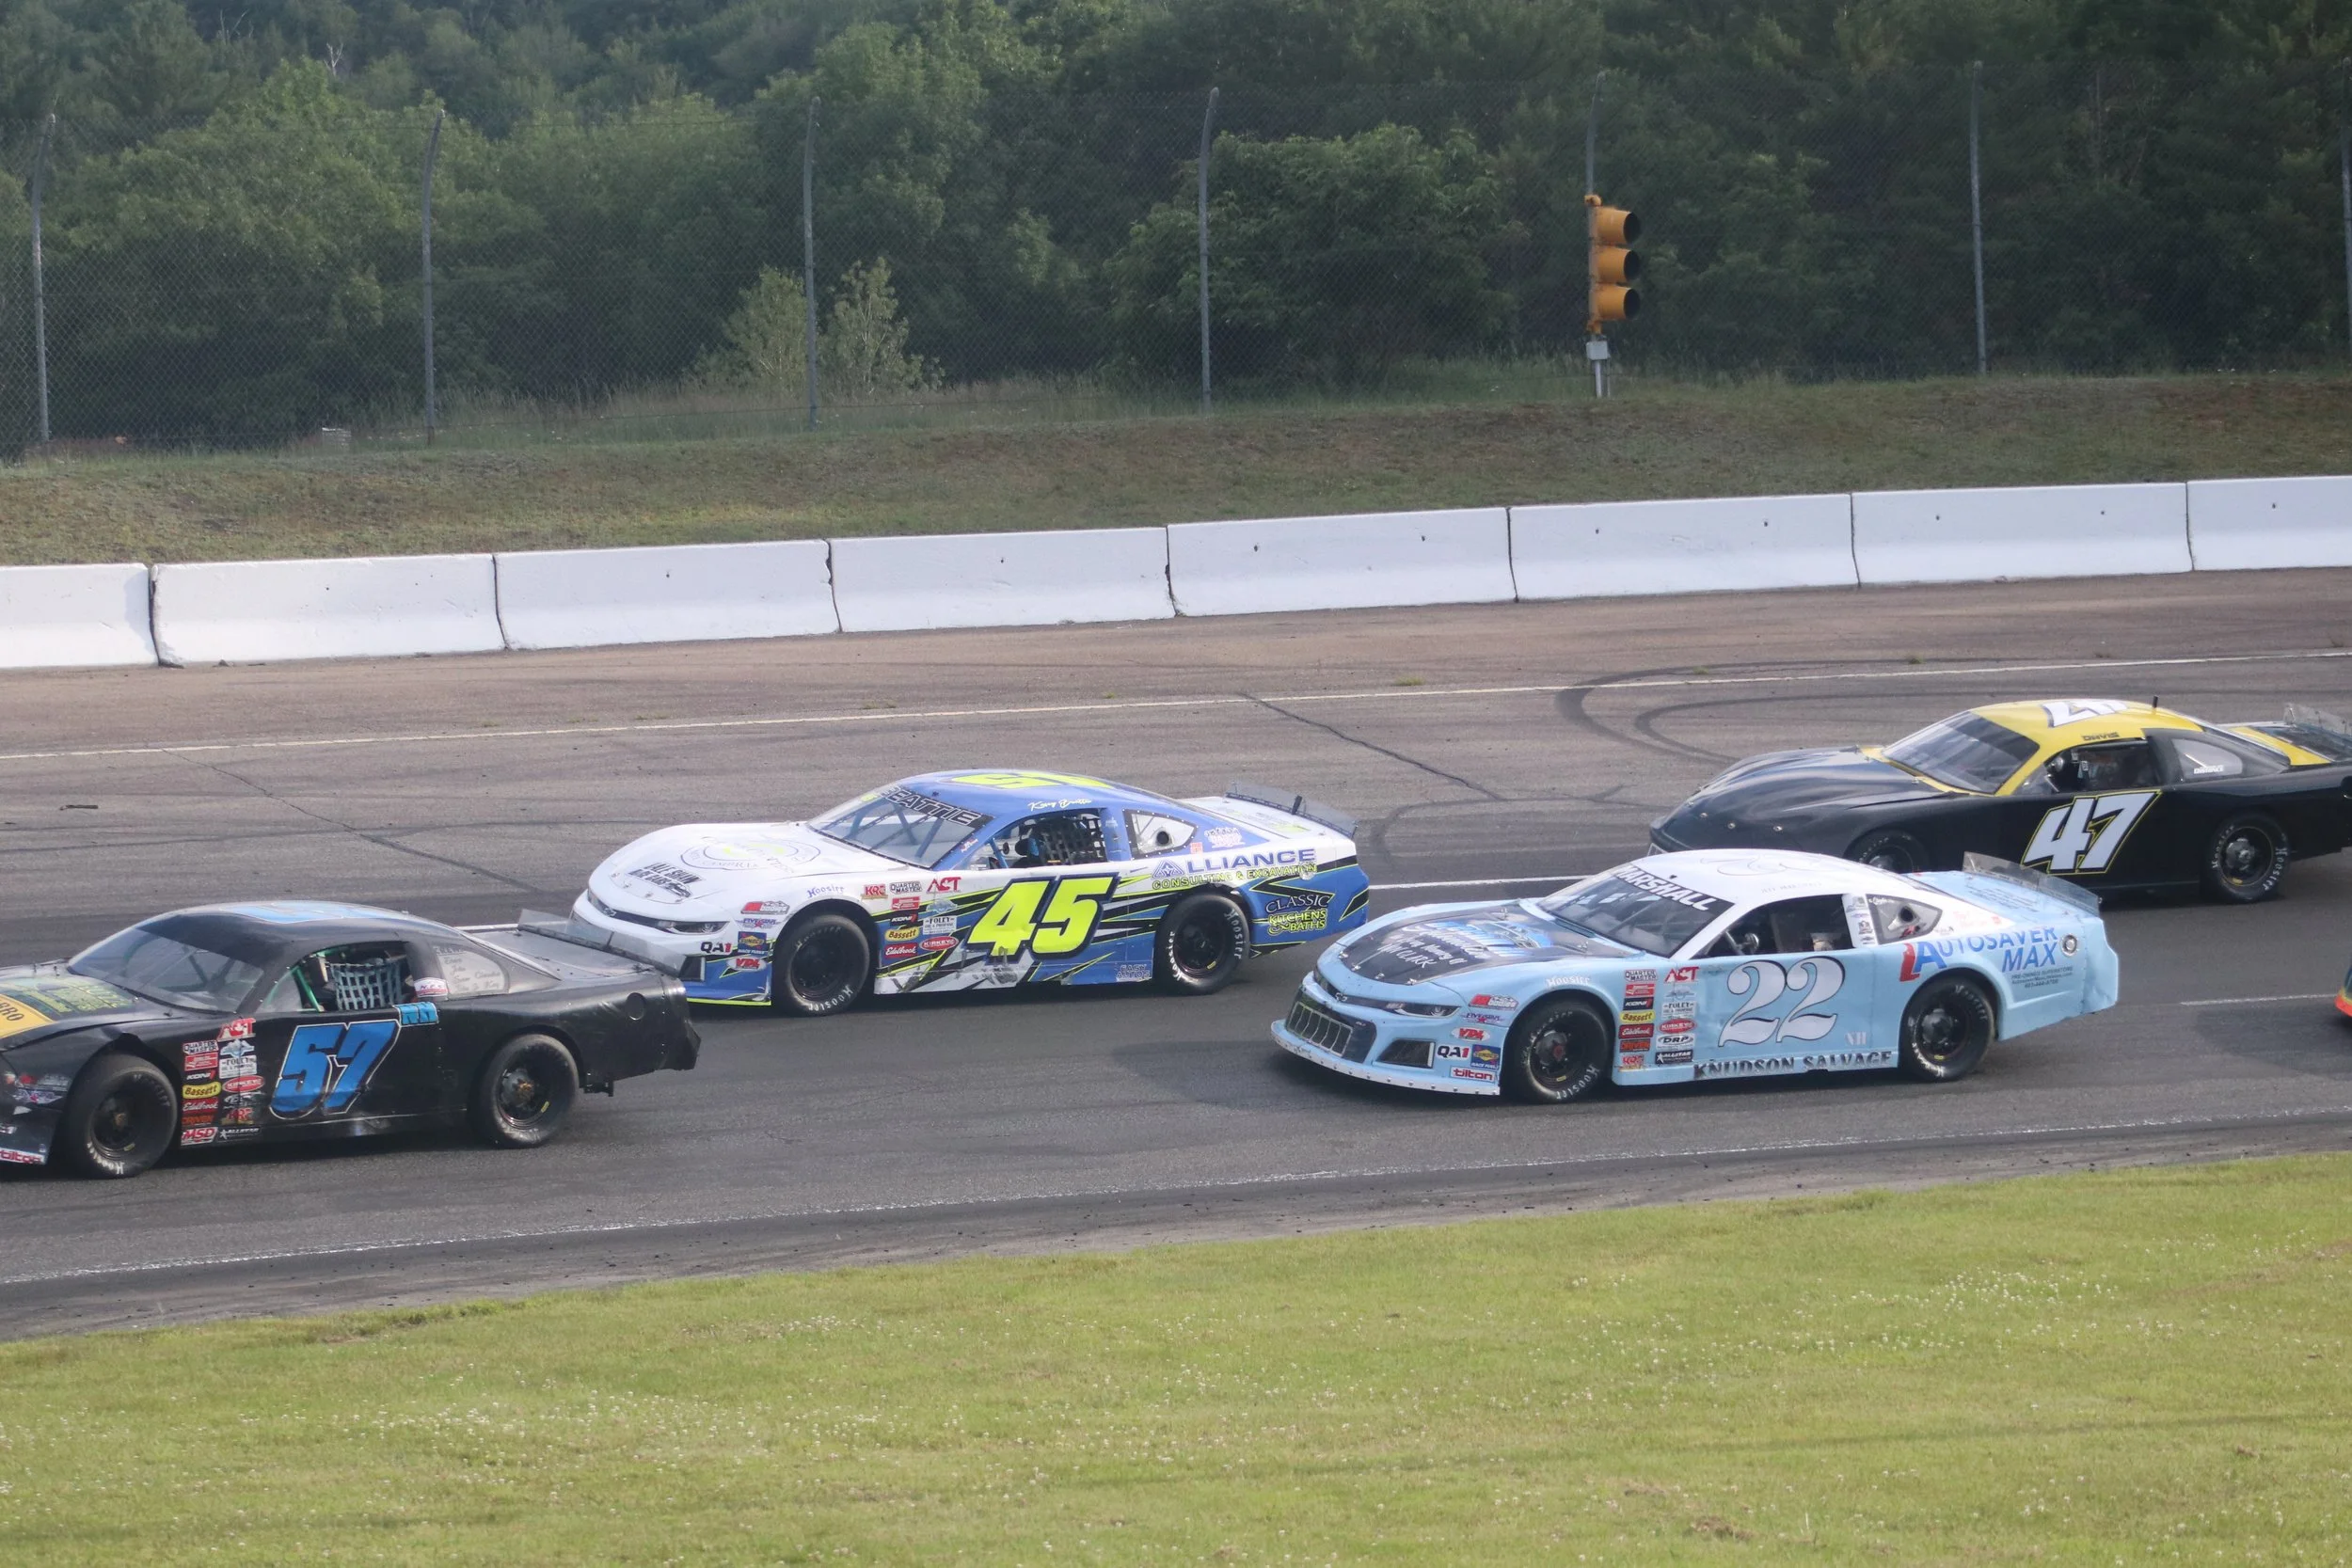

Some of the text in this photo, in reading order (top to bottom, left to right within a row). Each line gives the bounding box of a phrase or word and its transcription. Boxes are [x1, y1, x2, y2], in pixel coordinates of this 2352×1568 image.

[2021, 789, 2162, 875] 47
[890, 881, 921, 891] QUARTER
[1152, 874, 1232, 890] CONSULTING
[1235, 870, 1245, 879] &
[1614, 864, 1717, 911] MARSHALL
[1265, 894, 1329, 913] CLASSIC
[964, 872, 1120, 963] 45
[1268, 908, 1327, 926] KITCHENS
[1289, 920, 1327, 931] BATHS
[889, 929, 916, 939] Bassett
[1224, 909, 1242, 959] Hoosier
[701, 942, 732, 953] QA1
[885, 945, 916, 956] Edelbrock
[2002, 942, 2058, 973] MAX
[1547, 975, 1590, 988] Hoosier
[1718, 956, 1845, 1047] 22
[1623, 1013, 1652, 1022] Bassett
[1622, 1027, 1650, 1036] Edelbrock
[1662, 1036, 1689, 1044] DRP
[1437, 1045, 1470, 1057] QA1
[270, 1020, 401, 1119] 57
[1693, 1051, 1892, 1079] KNUDSON SALVAGE
[1453, 1069, 1493, 1081] tilton
[184, 1085, 217, 1096] Bassett
[183, 1101, 218, 1110] Edelbrock
[182, 1128, 215, 1139] MSD
